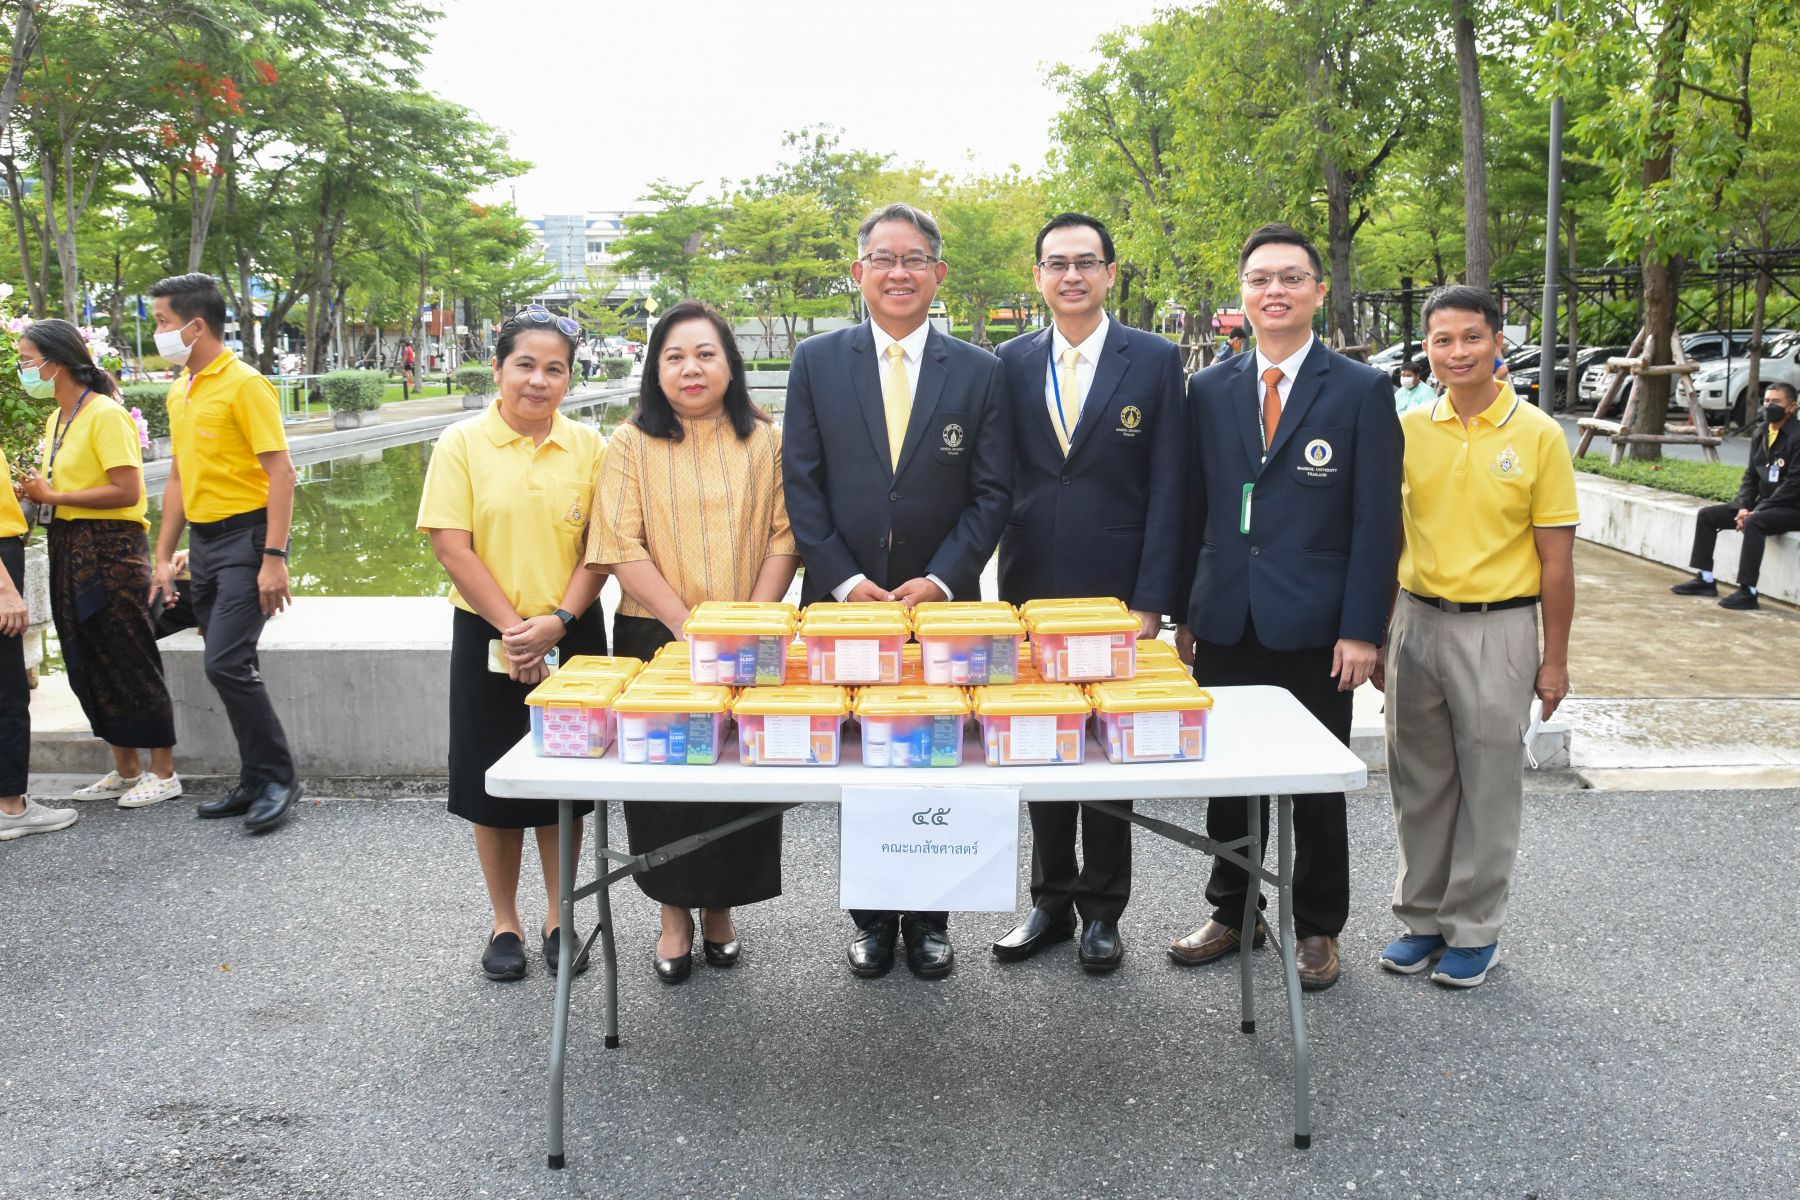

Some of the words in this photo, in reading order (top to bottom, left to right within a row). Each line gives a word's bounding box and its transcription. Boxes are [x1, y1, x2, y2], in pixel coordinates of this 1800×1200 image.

[912, 807, 951, 826] ๔๕
[881, 840, 979, 856] คณะเภสัชศาสตร์
